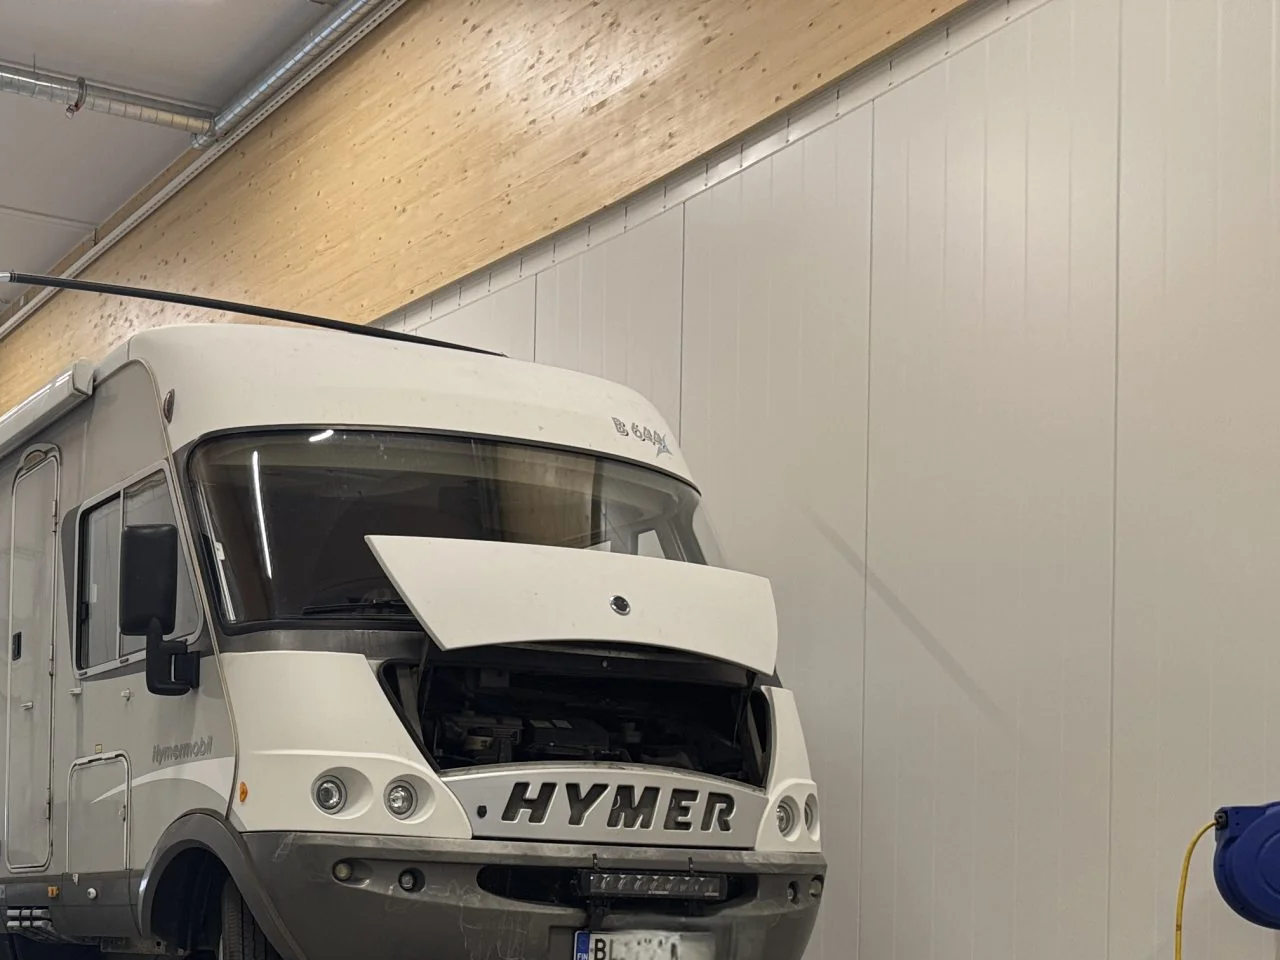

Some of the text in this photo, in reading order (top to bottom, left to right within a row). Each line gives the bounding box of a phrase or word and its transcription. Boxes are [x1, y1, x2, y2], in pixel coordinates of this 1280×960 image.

[611, 416, 629, 437] B
[501, 782, 736, 832] HYMER
[576, 953, 589, 960] FIN
